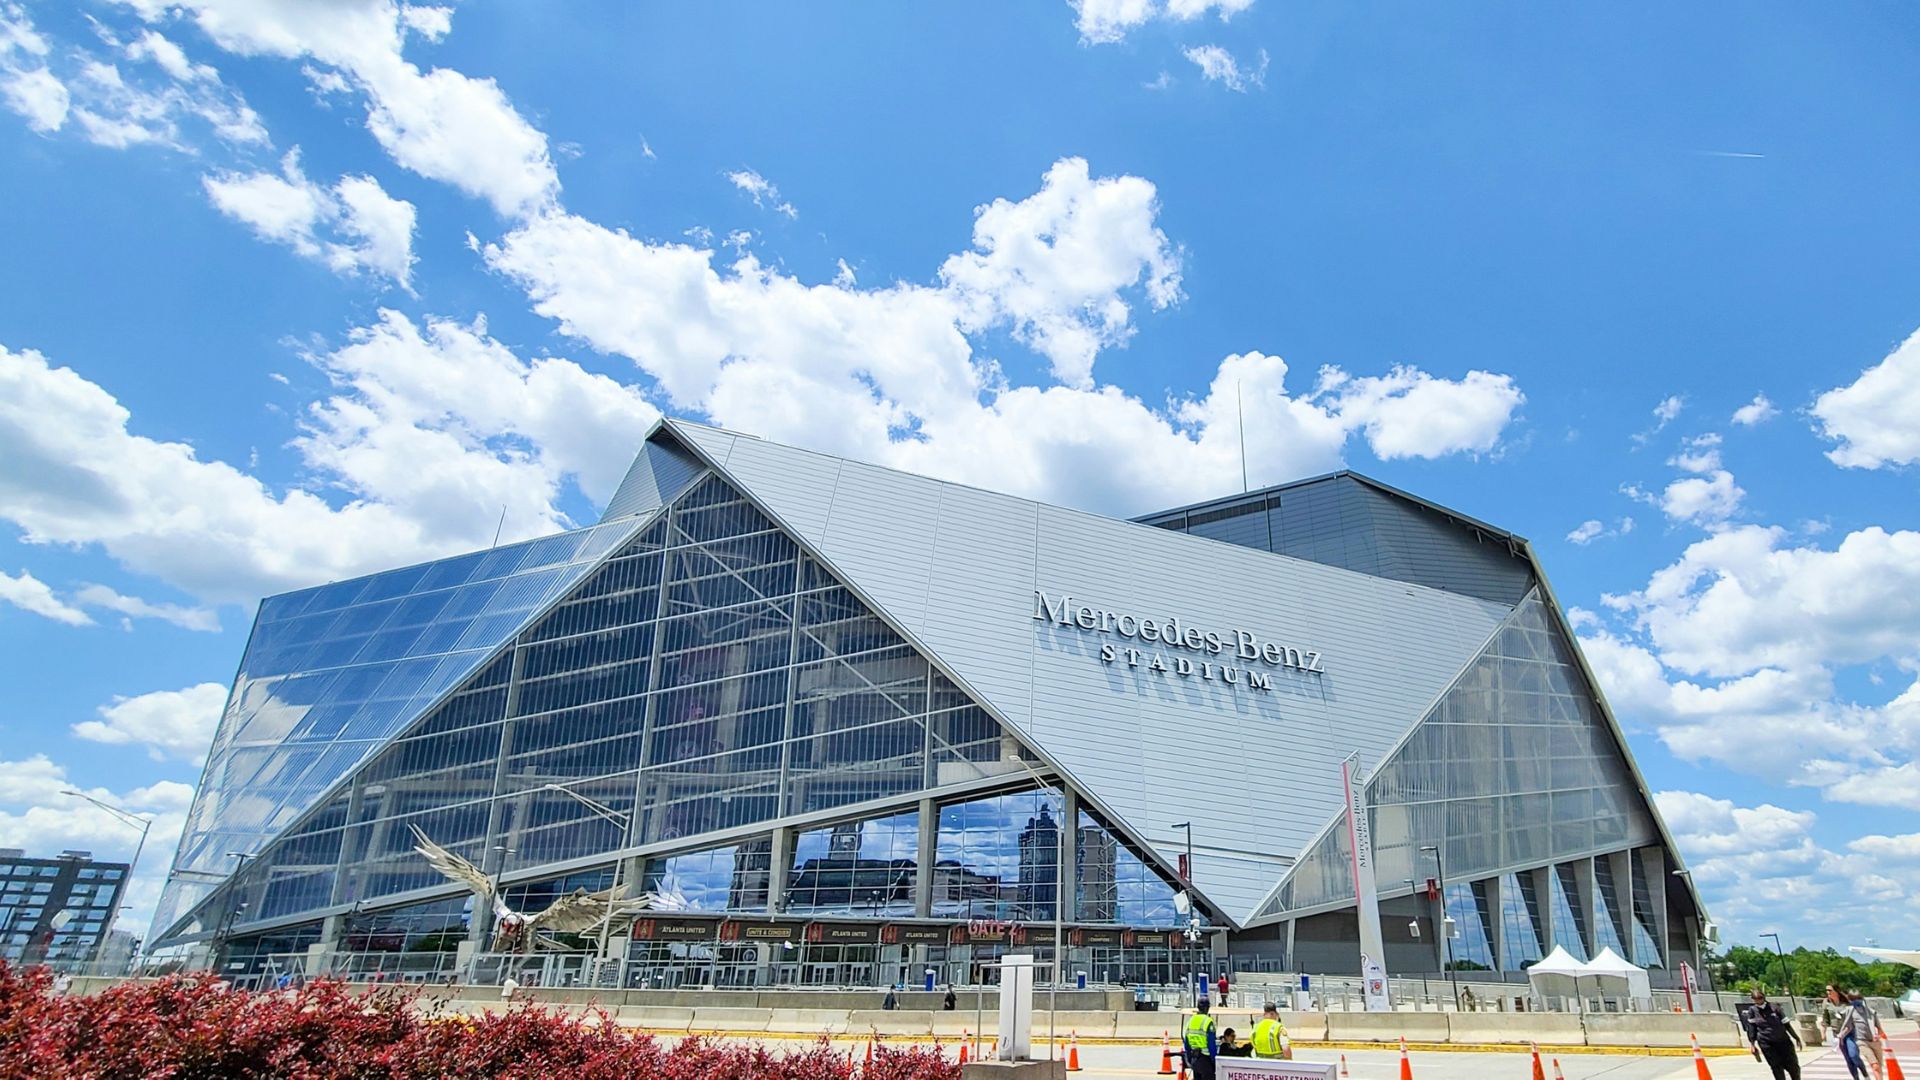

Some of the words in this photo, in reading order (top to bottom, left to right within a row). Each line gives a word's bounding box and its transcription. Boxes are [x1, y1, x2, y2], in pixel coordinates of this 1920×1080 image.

[1033, 590, 1325, 673] Mercedes-Benz
[1101, 644, 1272, 690] STADIUM
[968, 919, 1005, 937] GATE
